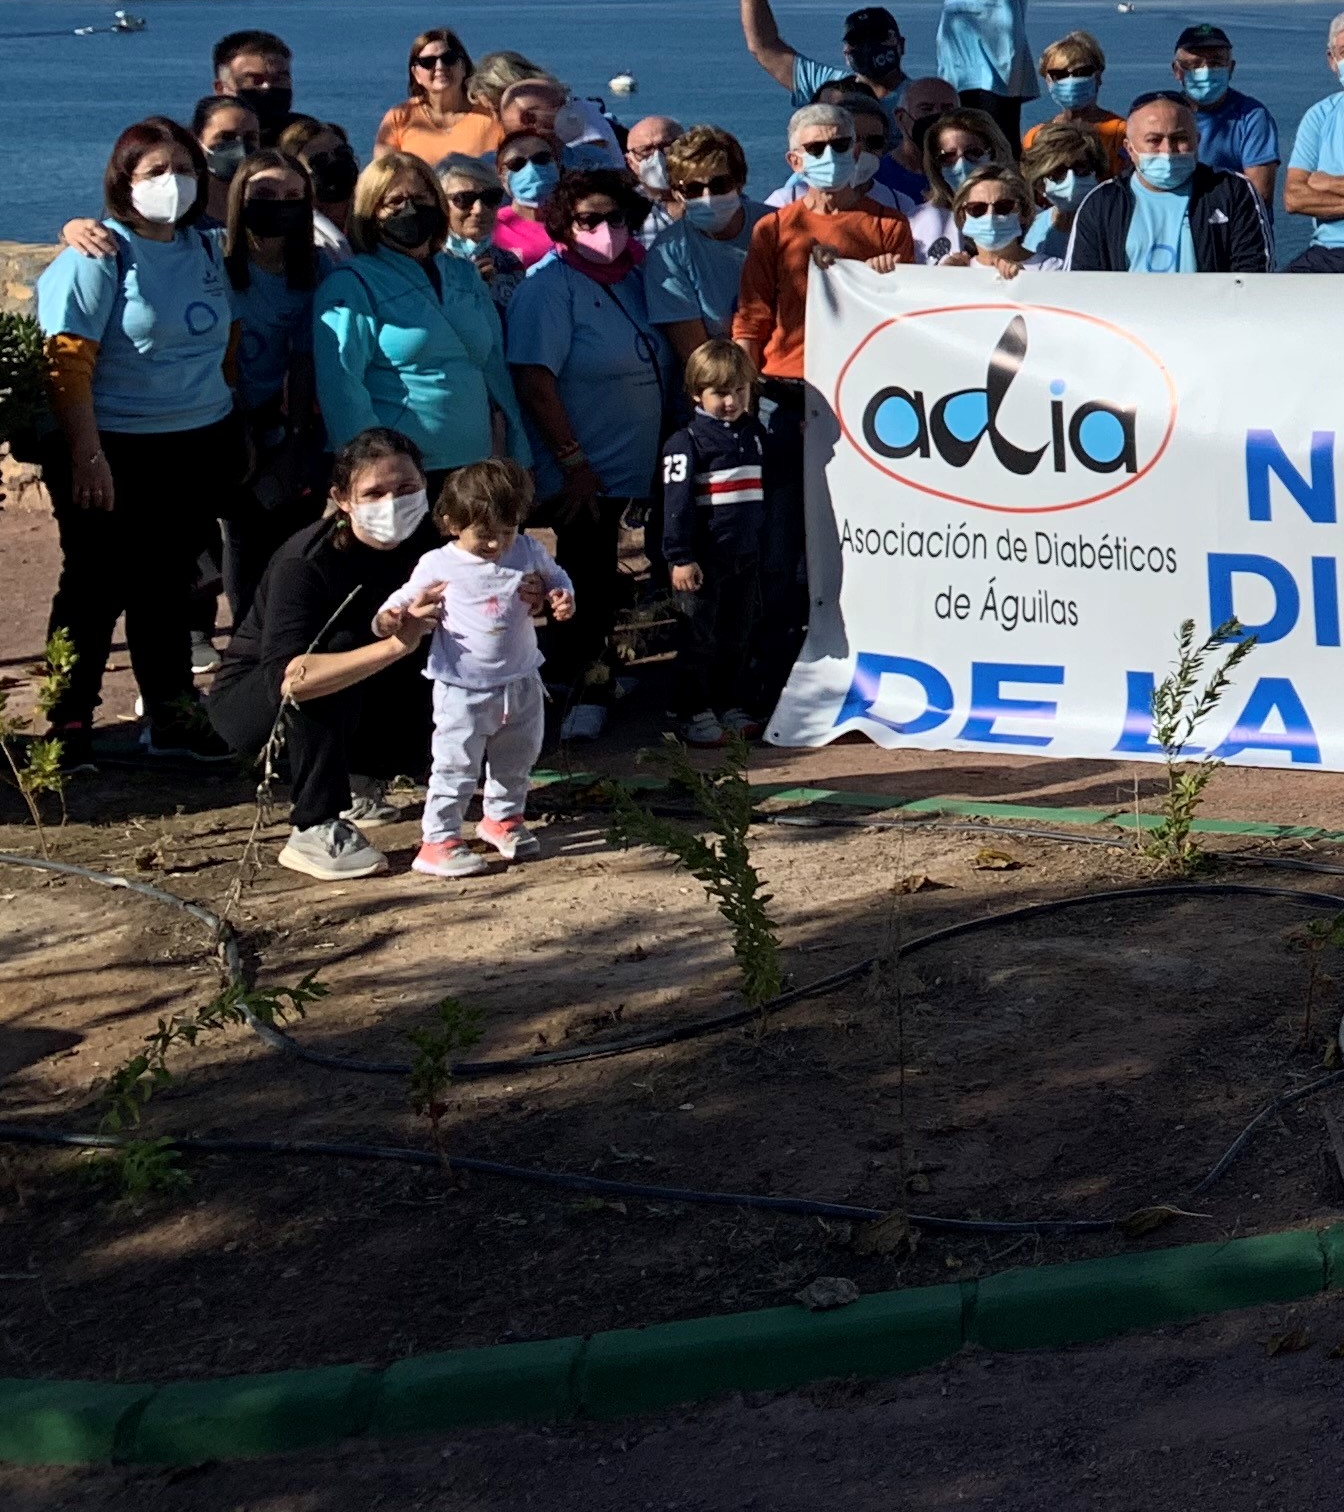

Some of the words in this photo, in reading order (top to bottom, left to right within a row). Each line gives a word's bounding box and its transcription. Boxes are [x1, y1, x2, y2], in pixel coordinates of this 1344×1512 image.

[840, 518, 987, 561] Asociación
[996, 528, 1029, 563] de
[1035, 531, 1178, 575] Diabéticos
[934, 584, 972, 621] de
[980, 578, 1080, 632] Águilas
[832, 651, 1066, 748] DE
[1112, 670, 1323, 765] LA
